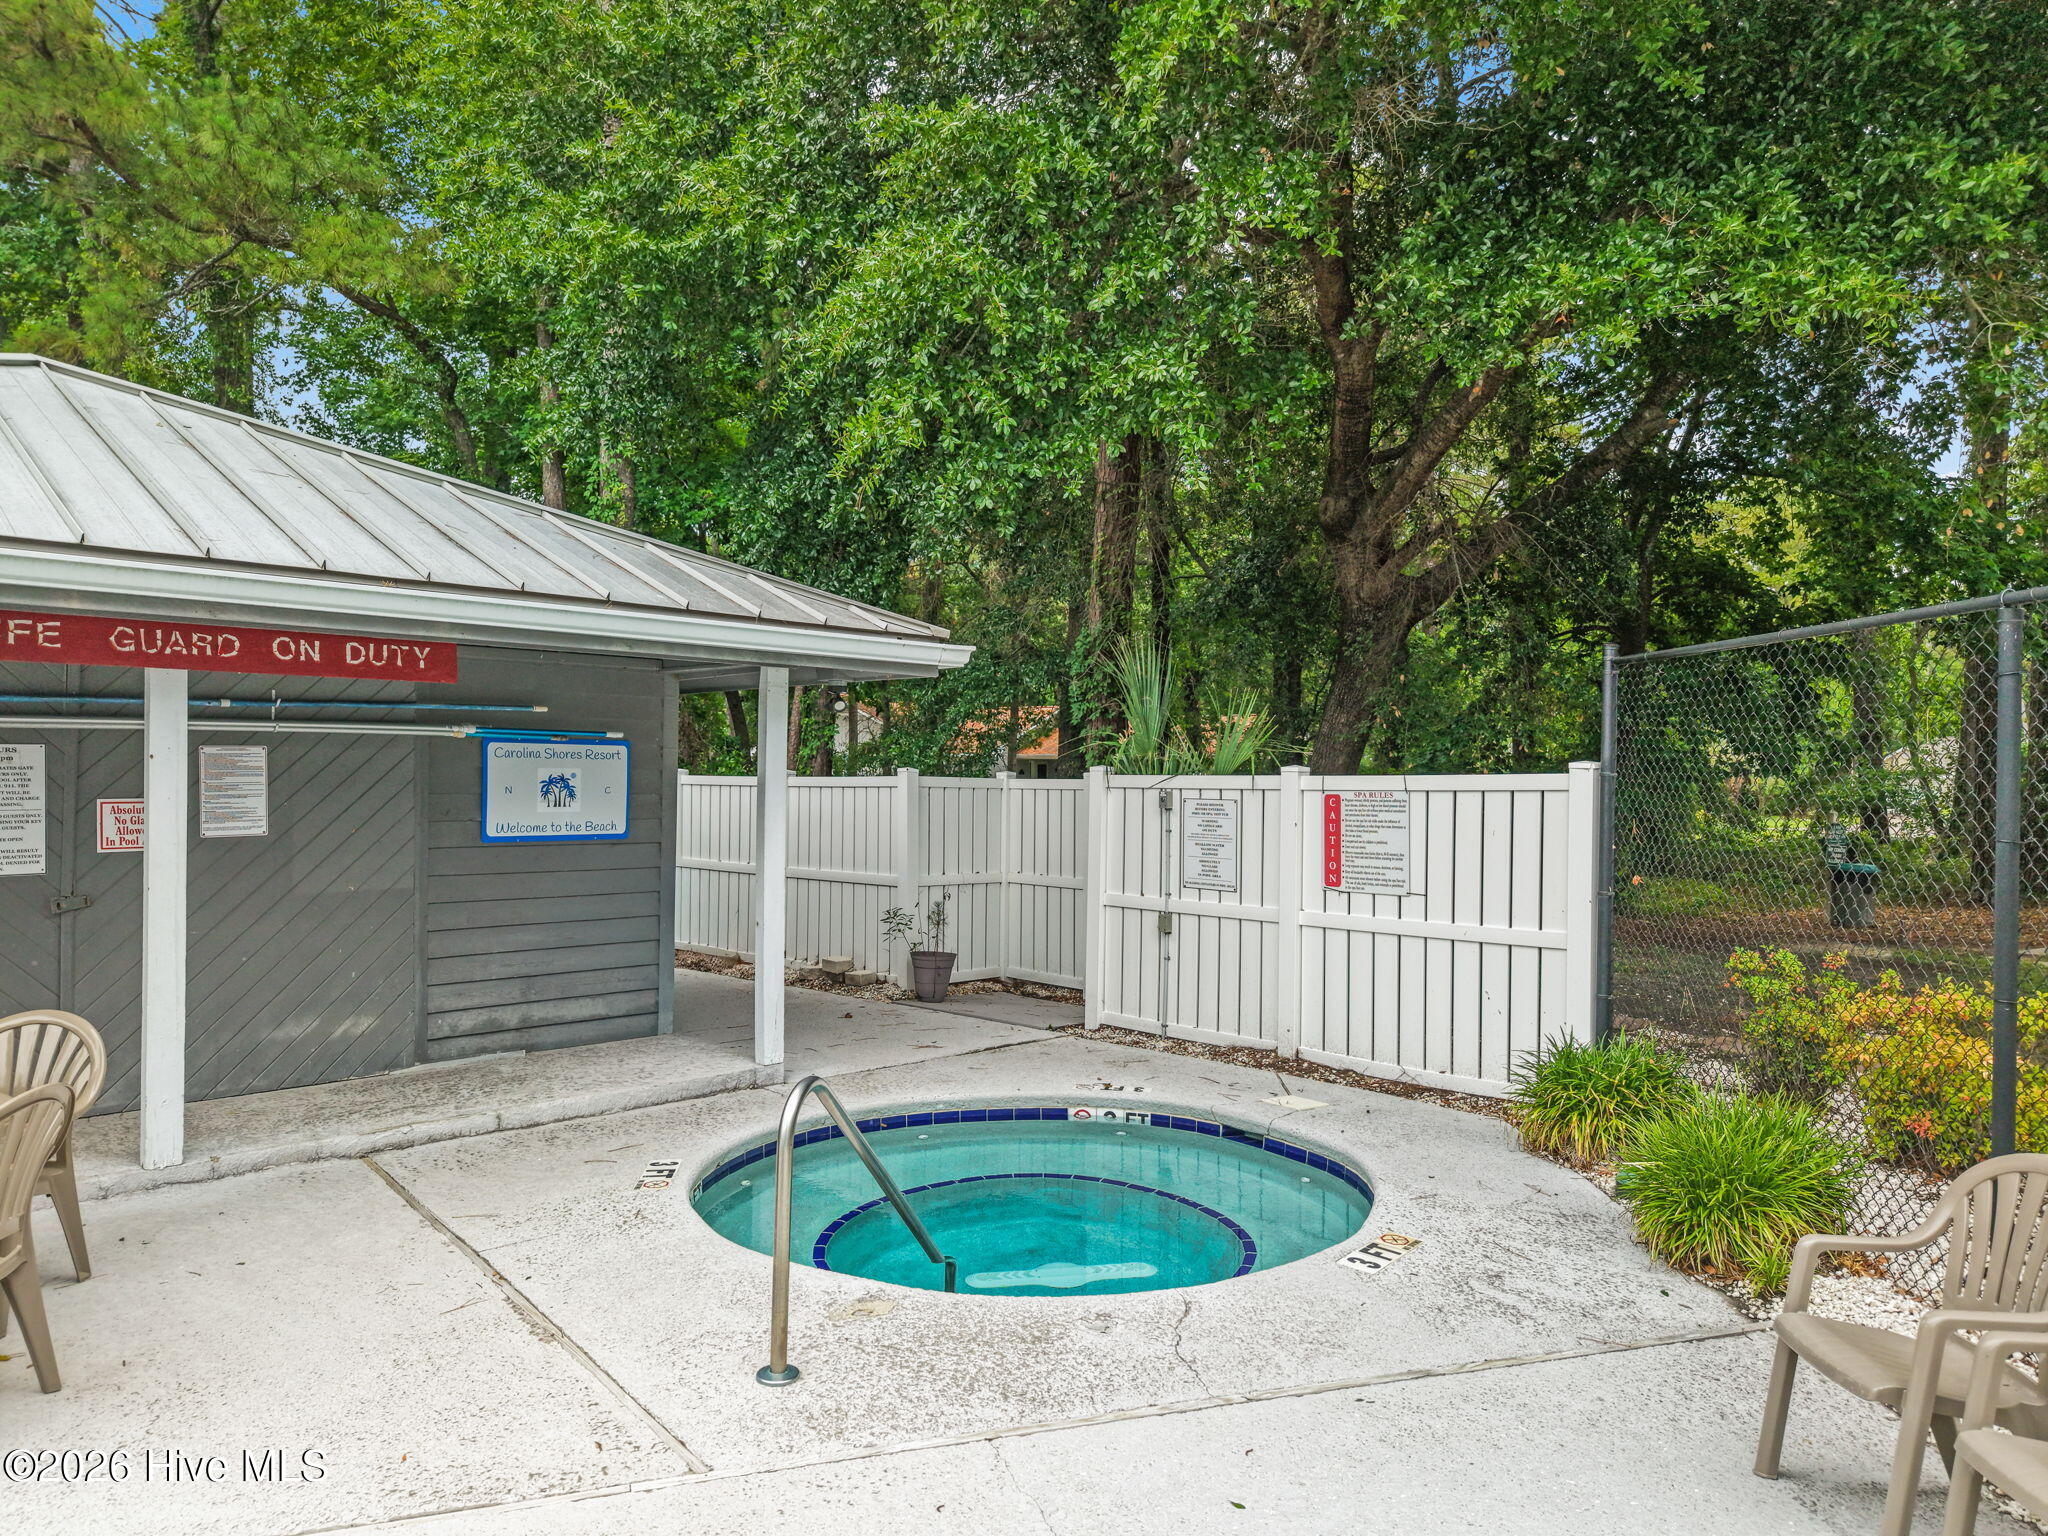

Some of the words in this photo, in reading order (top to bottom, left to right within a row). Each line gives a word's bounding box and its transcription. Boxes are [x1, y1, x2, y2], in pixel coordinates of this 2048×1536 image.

[109, 626, 240, 658] GUARD
[272, 636, 320, 662] ON
[346, 641, 430, 669] DUTY
[494, 746, 541, 760] Carolina
[544, 747, 582, 760] Shores
[585, 749, 622, 761] Resort
[504, 786, 513, 794] N
[604, 786, 611, 794] C
[1353, 791, 1367, 799] SPA
[1368, 791, 1394, 799] RULES
[114, 815, 127, 826] No
[495, 822, 548, 834] Welcome
[551, 821, 562, 833] to
[565, 821, 582, 832] the
[585, 821, 617, 832] Beach
[105, 837, 116, 847] In
[119, 836, 139, 846] Pool
[1328, 797, 1337, 883] CAUTION
[1125, 1111, 1149, 1125] FT
[642, 1168, 677, 1179] FT
[1358, 1242, 1402, 1262] FT
[1346, 1256, 1382, 1269] 3
